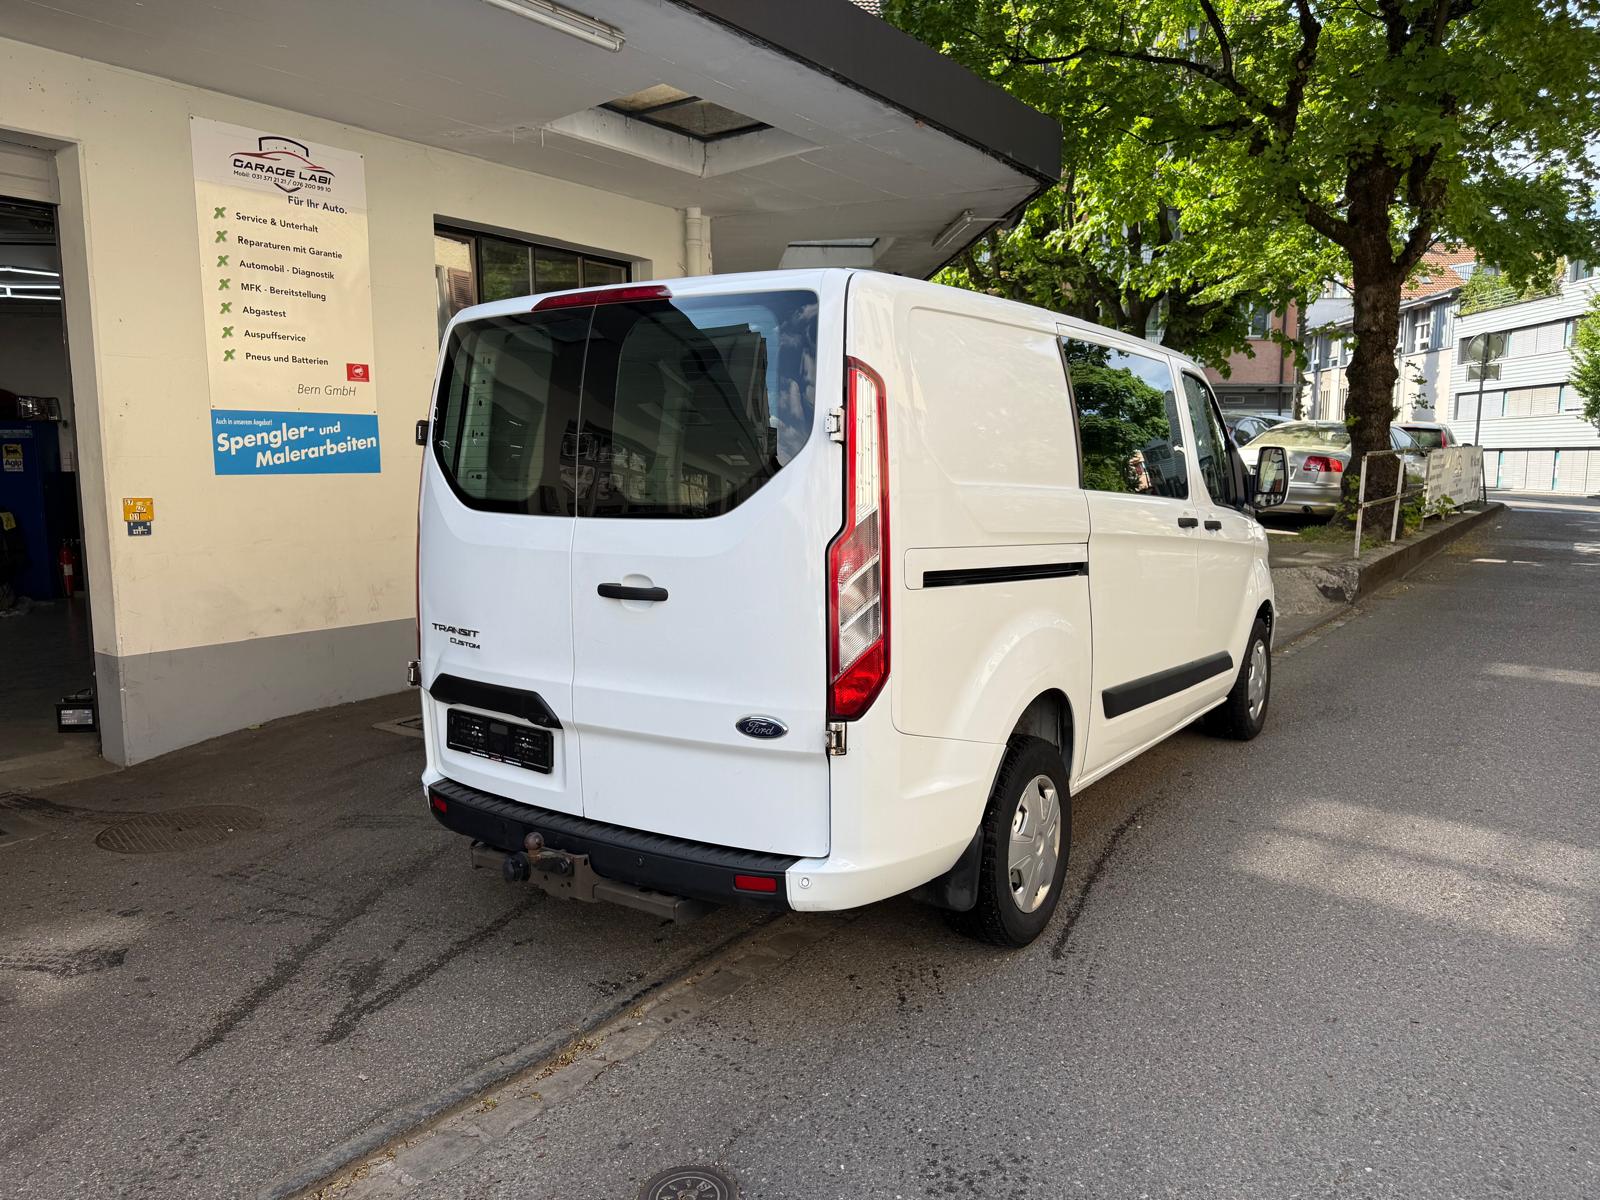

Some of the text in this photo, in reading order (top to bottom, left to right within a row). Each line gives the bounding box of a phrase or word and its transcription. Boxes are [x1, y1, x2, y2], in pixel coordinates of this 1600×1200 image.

[233, 159, 331, 185] GARAGE LABI
[292, 180, 303, 188] 076
[288, 195, 347, 215] Für Ihr Auto.
[235, 212, 319, 233] Service & Unterhalt
[237, 236, 343, 260] Reparaturen mit Garantie
[239, 260, 285, 273] Automobil
[292, 267, 335, 280] Diagnostik
[240, 283, 262, 293] MFK
[269, 287, 326, 302] Bereitstellung
[242, 306, 287, 318] Abgastest
[244, 330, 306, 343] Auspuffservice
[245, 352, 329, 366] Pneus und Batterien
[297, 384, 357, 397] Bern GmbH
[215, 417, 228, 425] Auch
[217, 423, 341, 455] Spengler- und
[256, 437, 376, 468] Malerarbeiten
[5, 459, 22, 467] Agip
[431, 622, 480, 637] TRANSIT
[449, 637, 481, 649] CUSTOM
[745, 720, 775, 735] Ford
